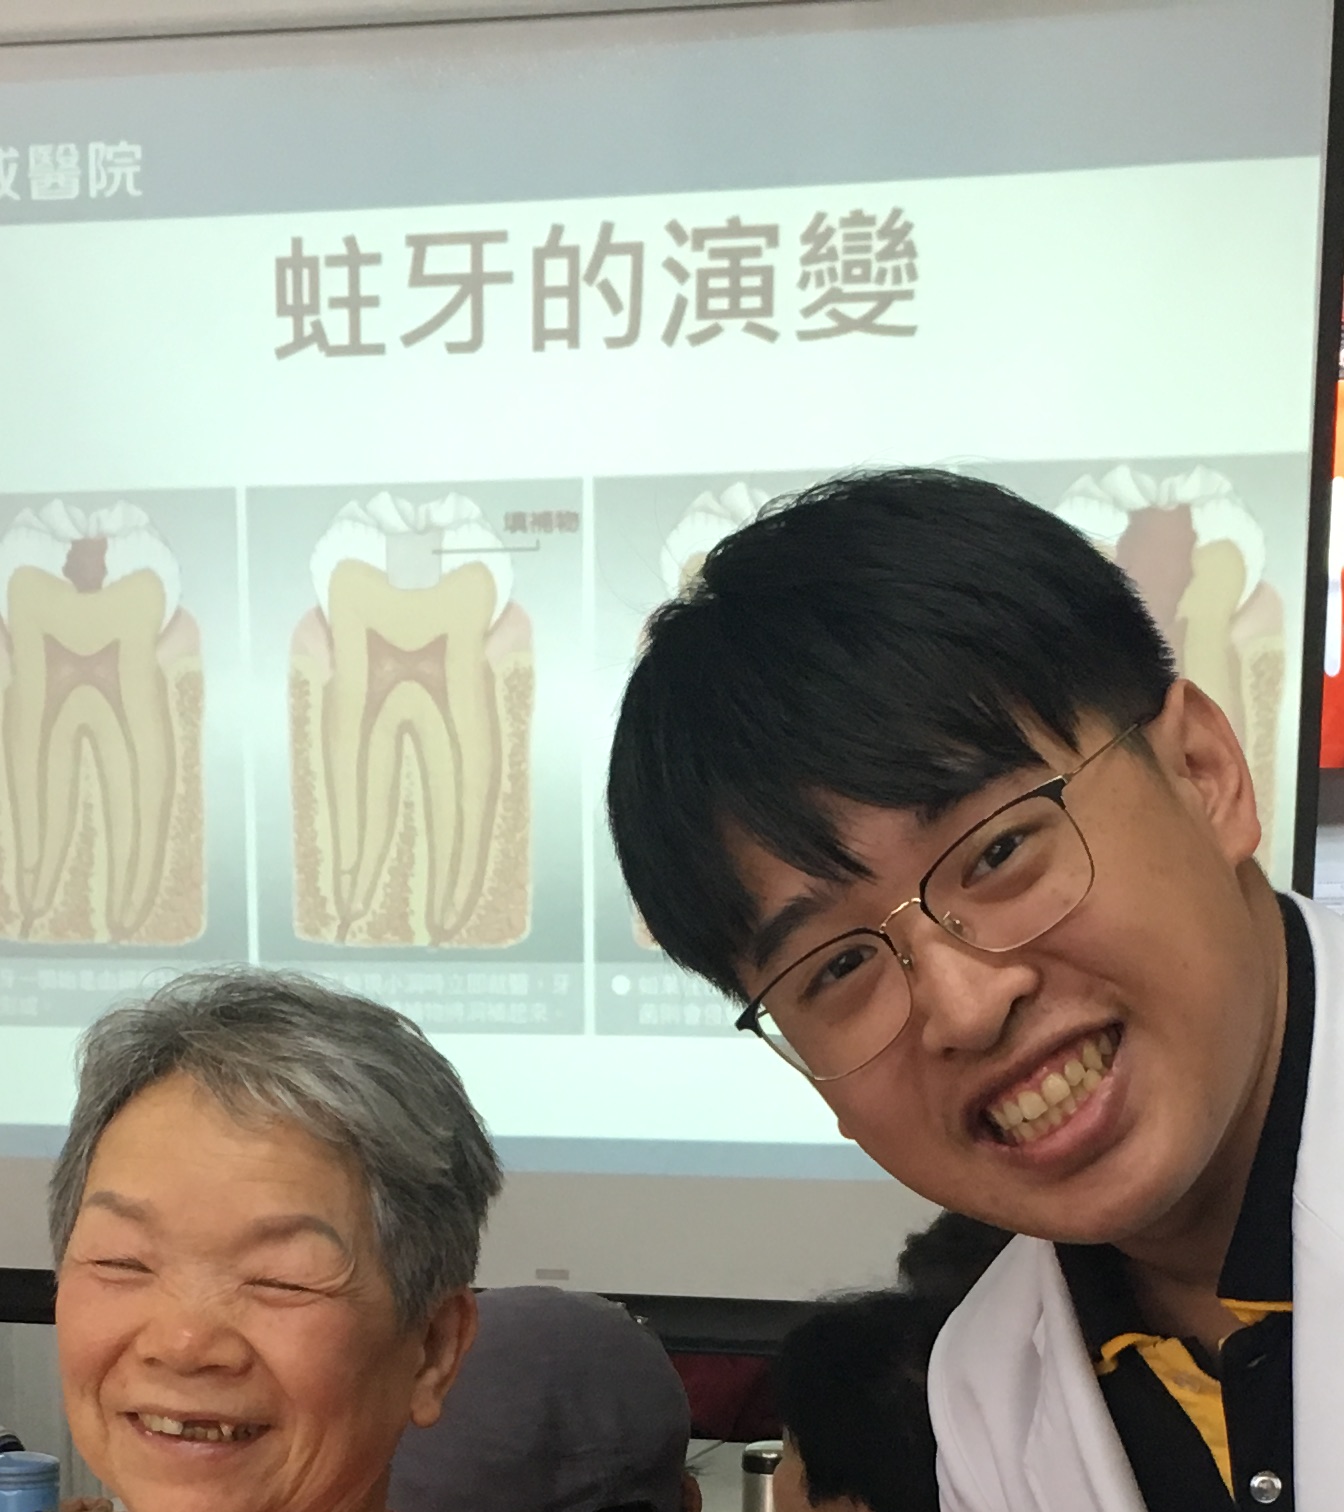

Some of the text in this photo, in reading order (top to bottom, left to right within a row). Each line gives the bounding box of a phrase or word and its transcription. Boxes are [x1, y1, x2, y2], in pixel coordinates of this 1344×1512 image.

[274, 206, 919, 360] 蛀牙的演變
